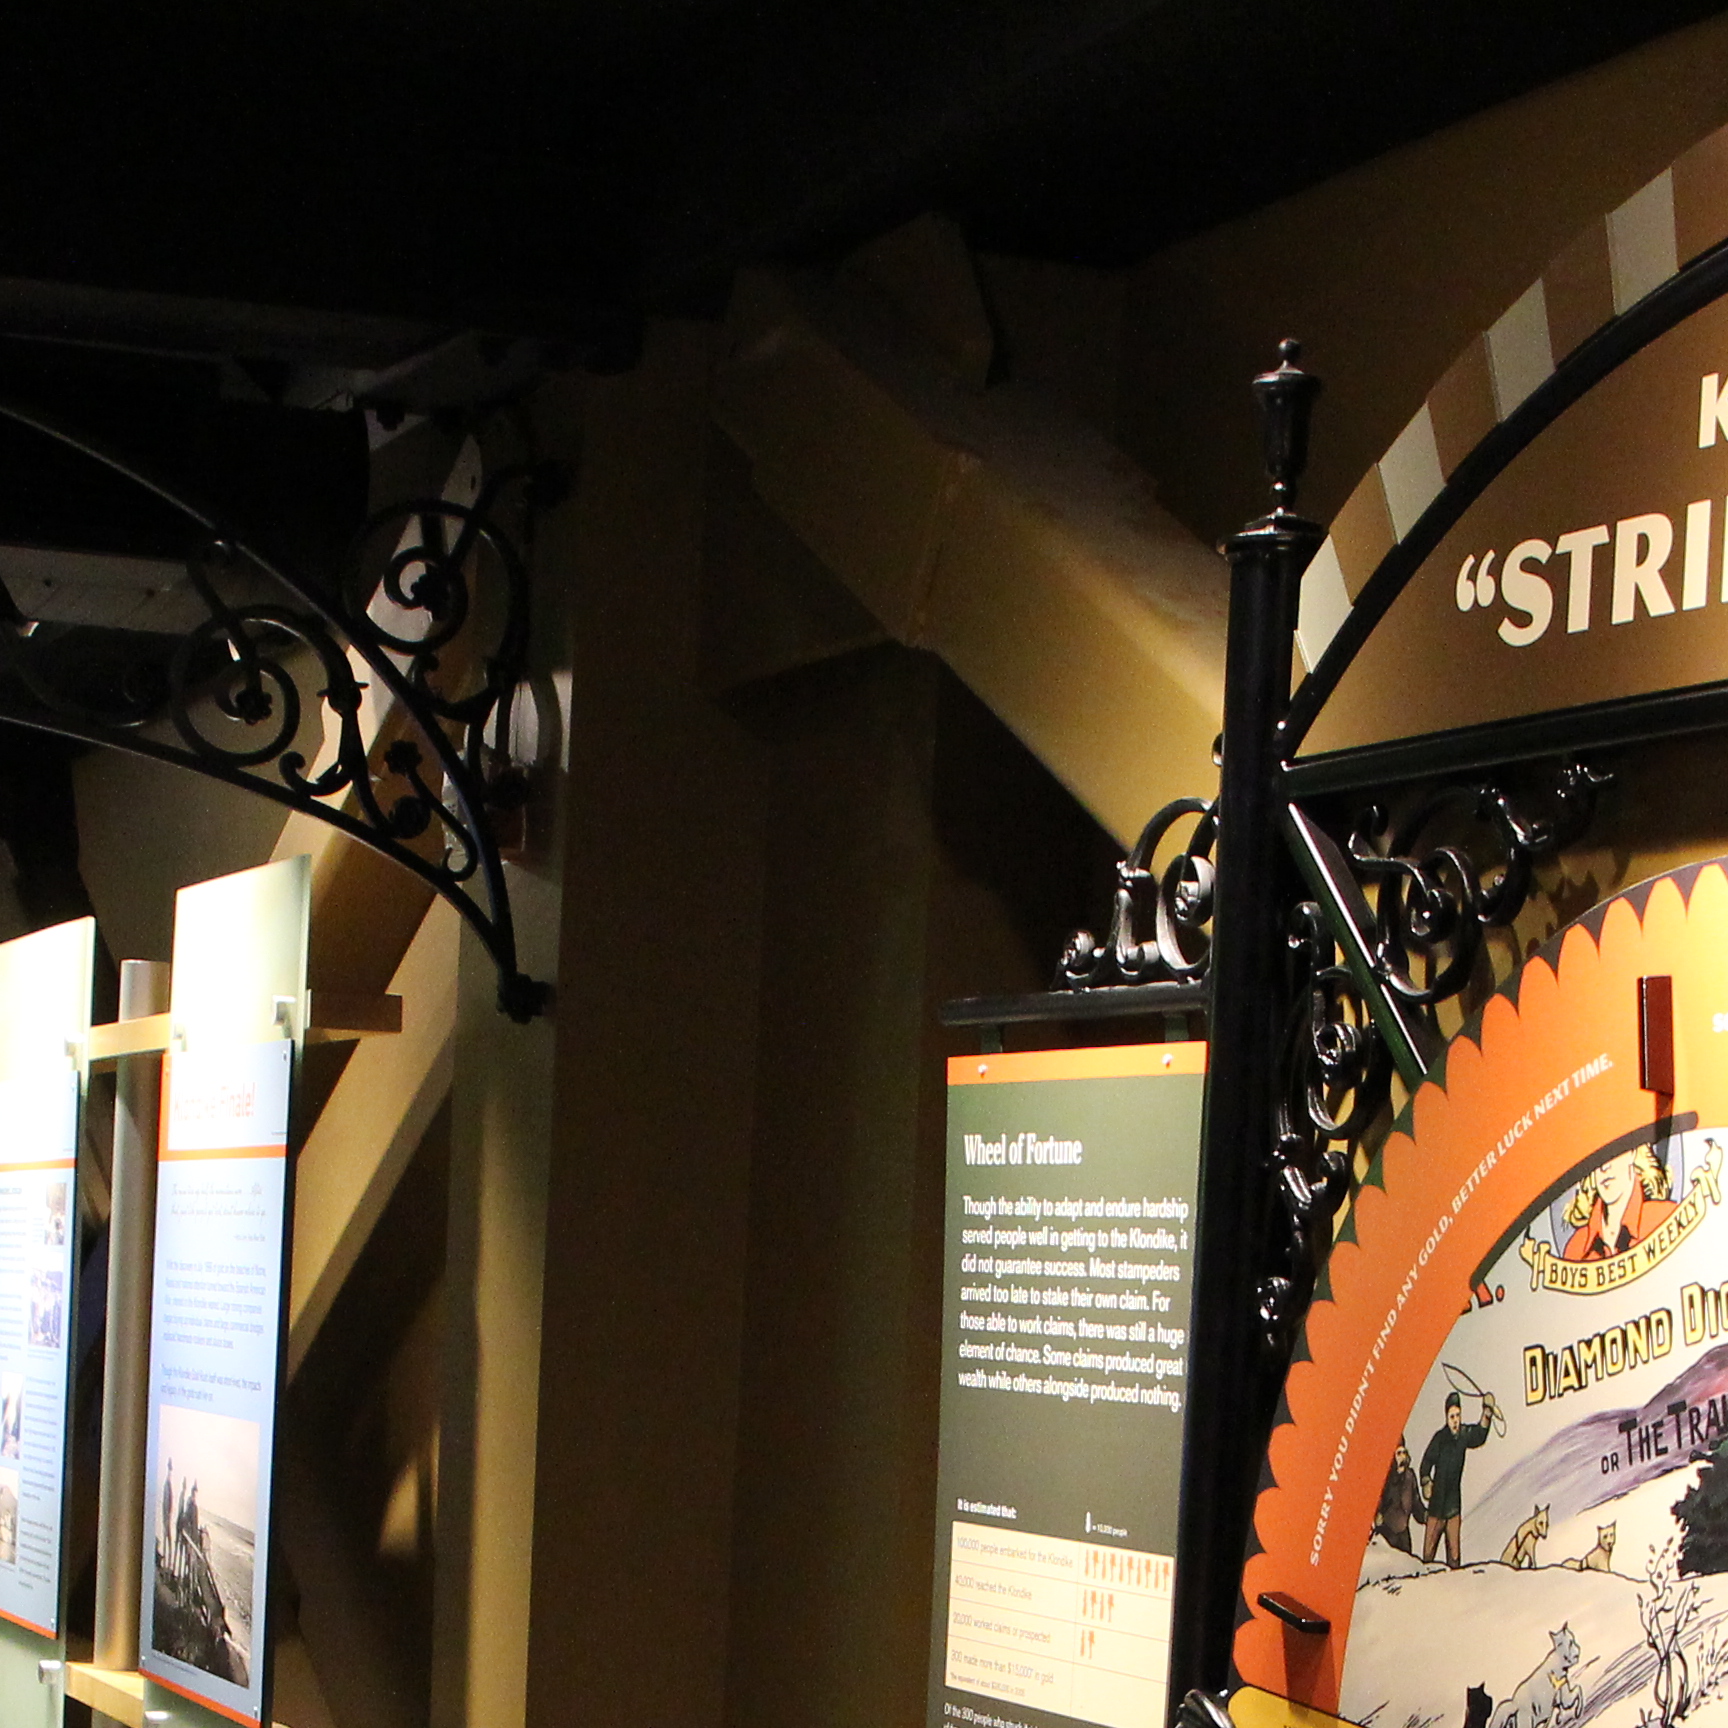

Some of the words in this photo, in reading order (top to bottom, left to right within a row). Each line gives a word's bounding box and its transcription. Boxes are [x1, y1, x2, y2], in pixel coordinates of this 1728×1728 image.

[964, 1133, 1006, 1165] Wheel
[1009, 1133, 1025, 1165] of
[1026, 1133, 1082, 1165] Fortune
[963, 1195, 996, 1220] Though
[1014, 1196, 1041, 1221] ability
[1055, 1197, 1082, 1221] adapt
[1085, 1197, 1104, 1216] and
[1105, 1197, 1140, 1217] endure
[1143, 1197, 1189, 1223] hardship
[962, 1225, 993, 1245] served
[994, 1226, 1026, 1249] people
[1029, 1227, 1048, 1245] well
[1061, 1228, 1095, 1252] getting
[1129, 1227, 1177, 1252] Klondike,
[1549, 1263, 1588, 1288] BOYS
[1596, 1254, 1637, 1287] BEST
[1643, 1192, 1698, 1265] WEEKLY
[995, 1258, 1041, 1278] guarantee
[1044, 1261, 1087, 1277] success.
[1090, 1258, 1115, 1278] Most
[1118, 1260, 1180, 1284] stampeders
[960, 1283, 991, 1300] arrived
[1011, 1284, 1028, 1303] late
[1042, 1286, 1068, 1306] stake
[1071, 1287, 1093, 1307] their
[1119, 1290, 1149, 1309] claim.
[1152, 1290, 1170, 1311] For
[1310, 1486, 1334, 1566] SORRY
[1329, 1436, 1348, 1481] YOU
[1345, 1359, 1375, 1434] DIDN'T
[1373, 1309, 1397, 1359] FIND
[1397, 1264, 1418, 1310] ANY
[1419, 1215, 1453, 1266] GOLD,
[1451, 1150, 1497, 1214] BETTER
[1497, 1110, 1533, 1157] LUCK
[1534, 1078, 1571, 1120] NEXT
[1572, 1053, 1613, 1088] TIME.
[960, 1311, 984, 1330] those
[987, 1312, 1006, 1331] able
[1019, 1315, 1042, 1334] work
[1044, 1316, 1077, 1339] claims,
[1079, 1318, 1104, 1338] there
[1106, 1325, 1127, 1340] was
[1129, 1321, 1146, 1341] still
[1157, 1323, 1184, 1349] huge
[959, 1339, 993, 1360] element
[1006, 1343, 1041, 1364] chance.
[1043, 1344, 1071, 1366] Some
[1073, 1348, 1103, 1368] claims
[1105, 1352, 1154, 1375] produced
[1156, 1357, 1184, 1379] great
[1523, 1308, 1673, 1406] DIAMOND
[958, 1369, 987, 1388] wealth
[989, 1370, 1011, 1390] while
[1013, 1373, 1041, 1393] others
[1043, 1375, 1088, 1401] alongside
[1091, 1380, 1139, 1404] produced
[1141, 1384, 1181, 1412] nothing.
[1618, 1418, 1668, 1465] THE
